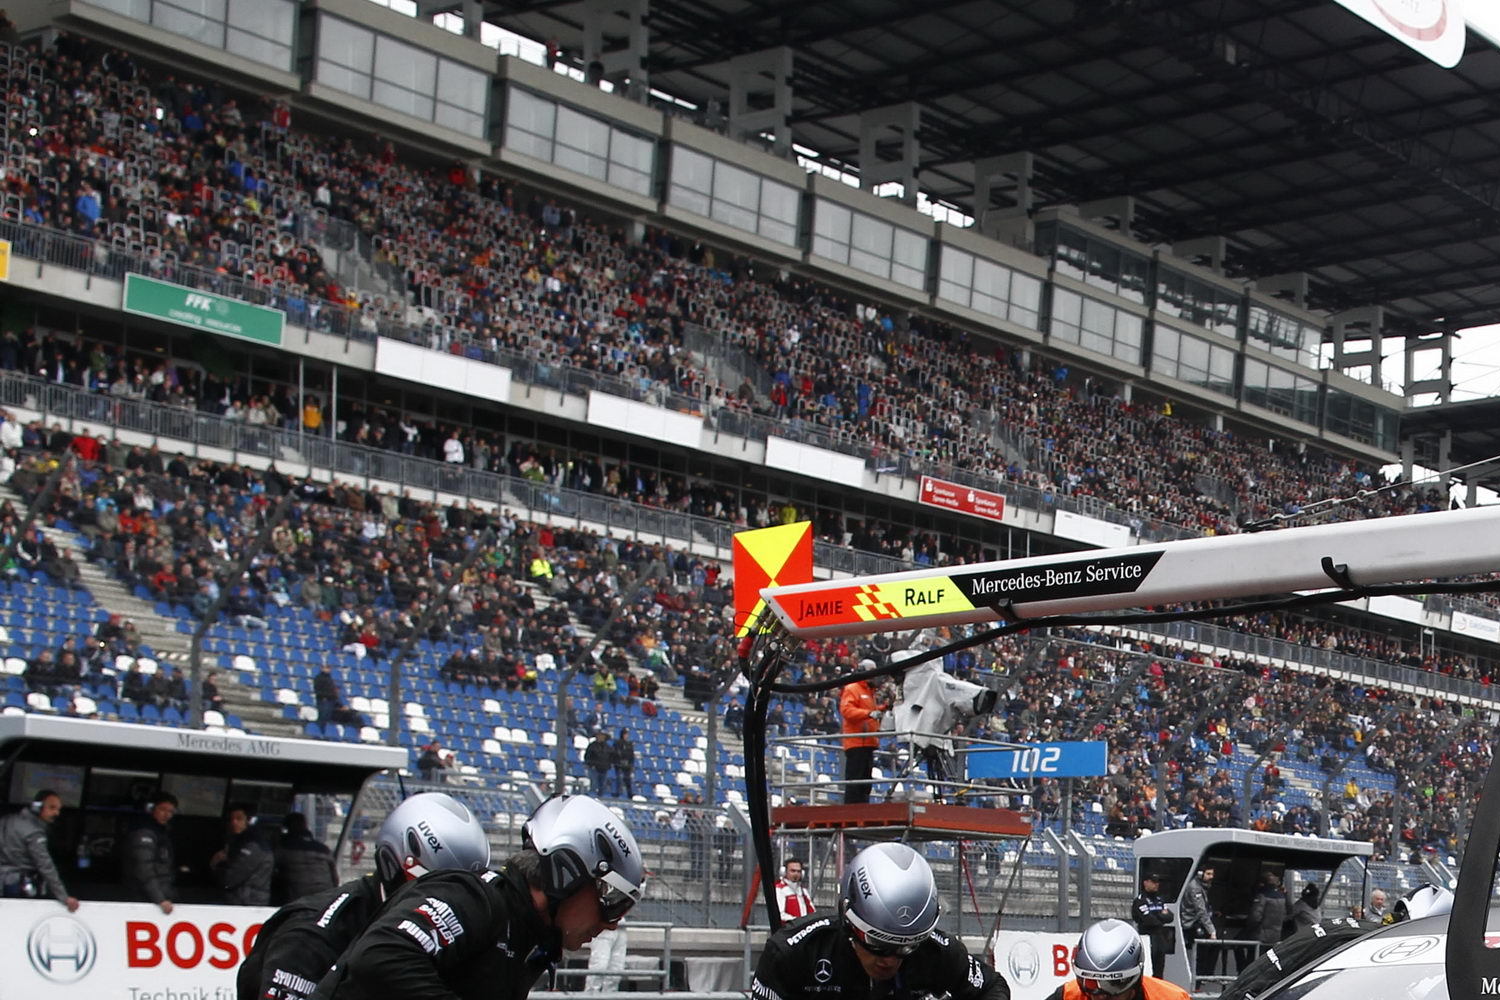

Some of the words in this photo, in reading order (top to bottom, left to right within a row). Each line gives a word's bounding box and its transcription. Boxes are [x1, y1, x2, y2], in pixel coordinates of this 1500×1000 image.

[799, 599, 844, 622] JAMIE
[904, 588, 946, 607] RALF
[971, 570, 1083, 597] Mercedes-Benz
[1085, 563, 1143, 583] Service
[177, 732, 243, 752] Mercedes
[248, 740, 281, 756] AMG
[1011, 746, 1062, 773] 102
[417, 820, 444, 854] uvex
[605, 821, 632, 858] uvex
[857, 866, 874, 900] uvex
[787, 918, 831, 947] PETRONAS
